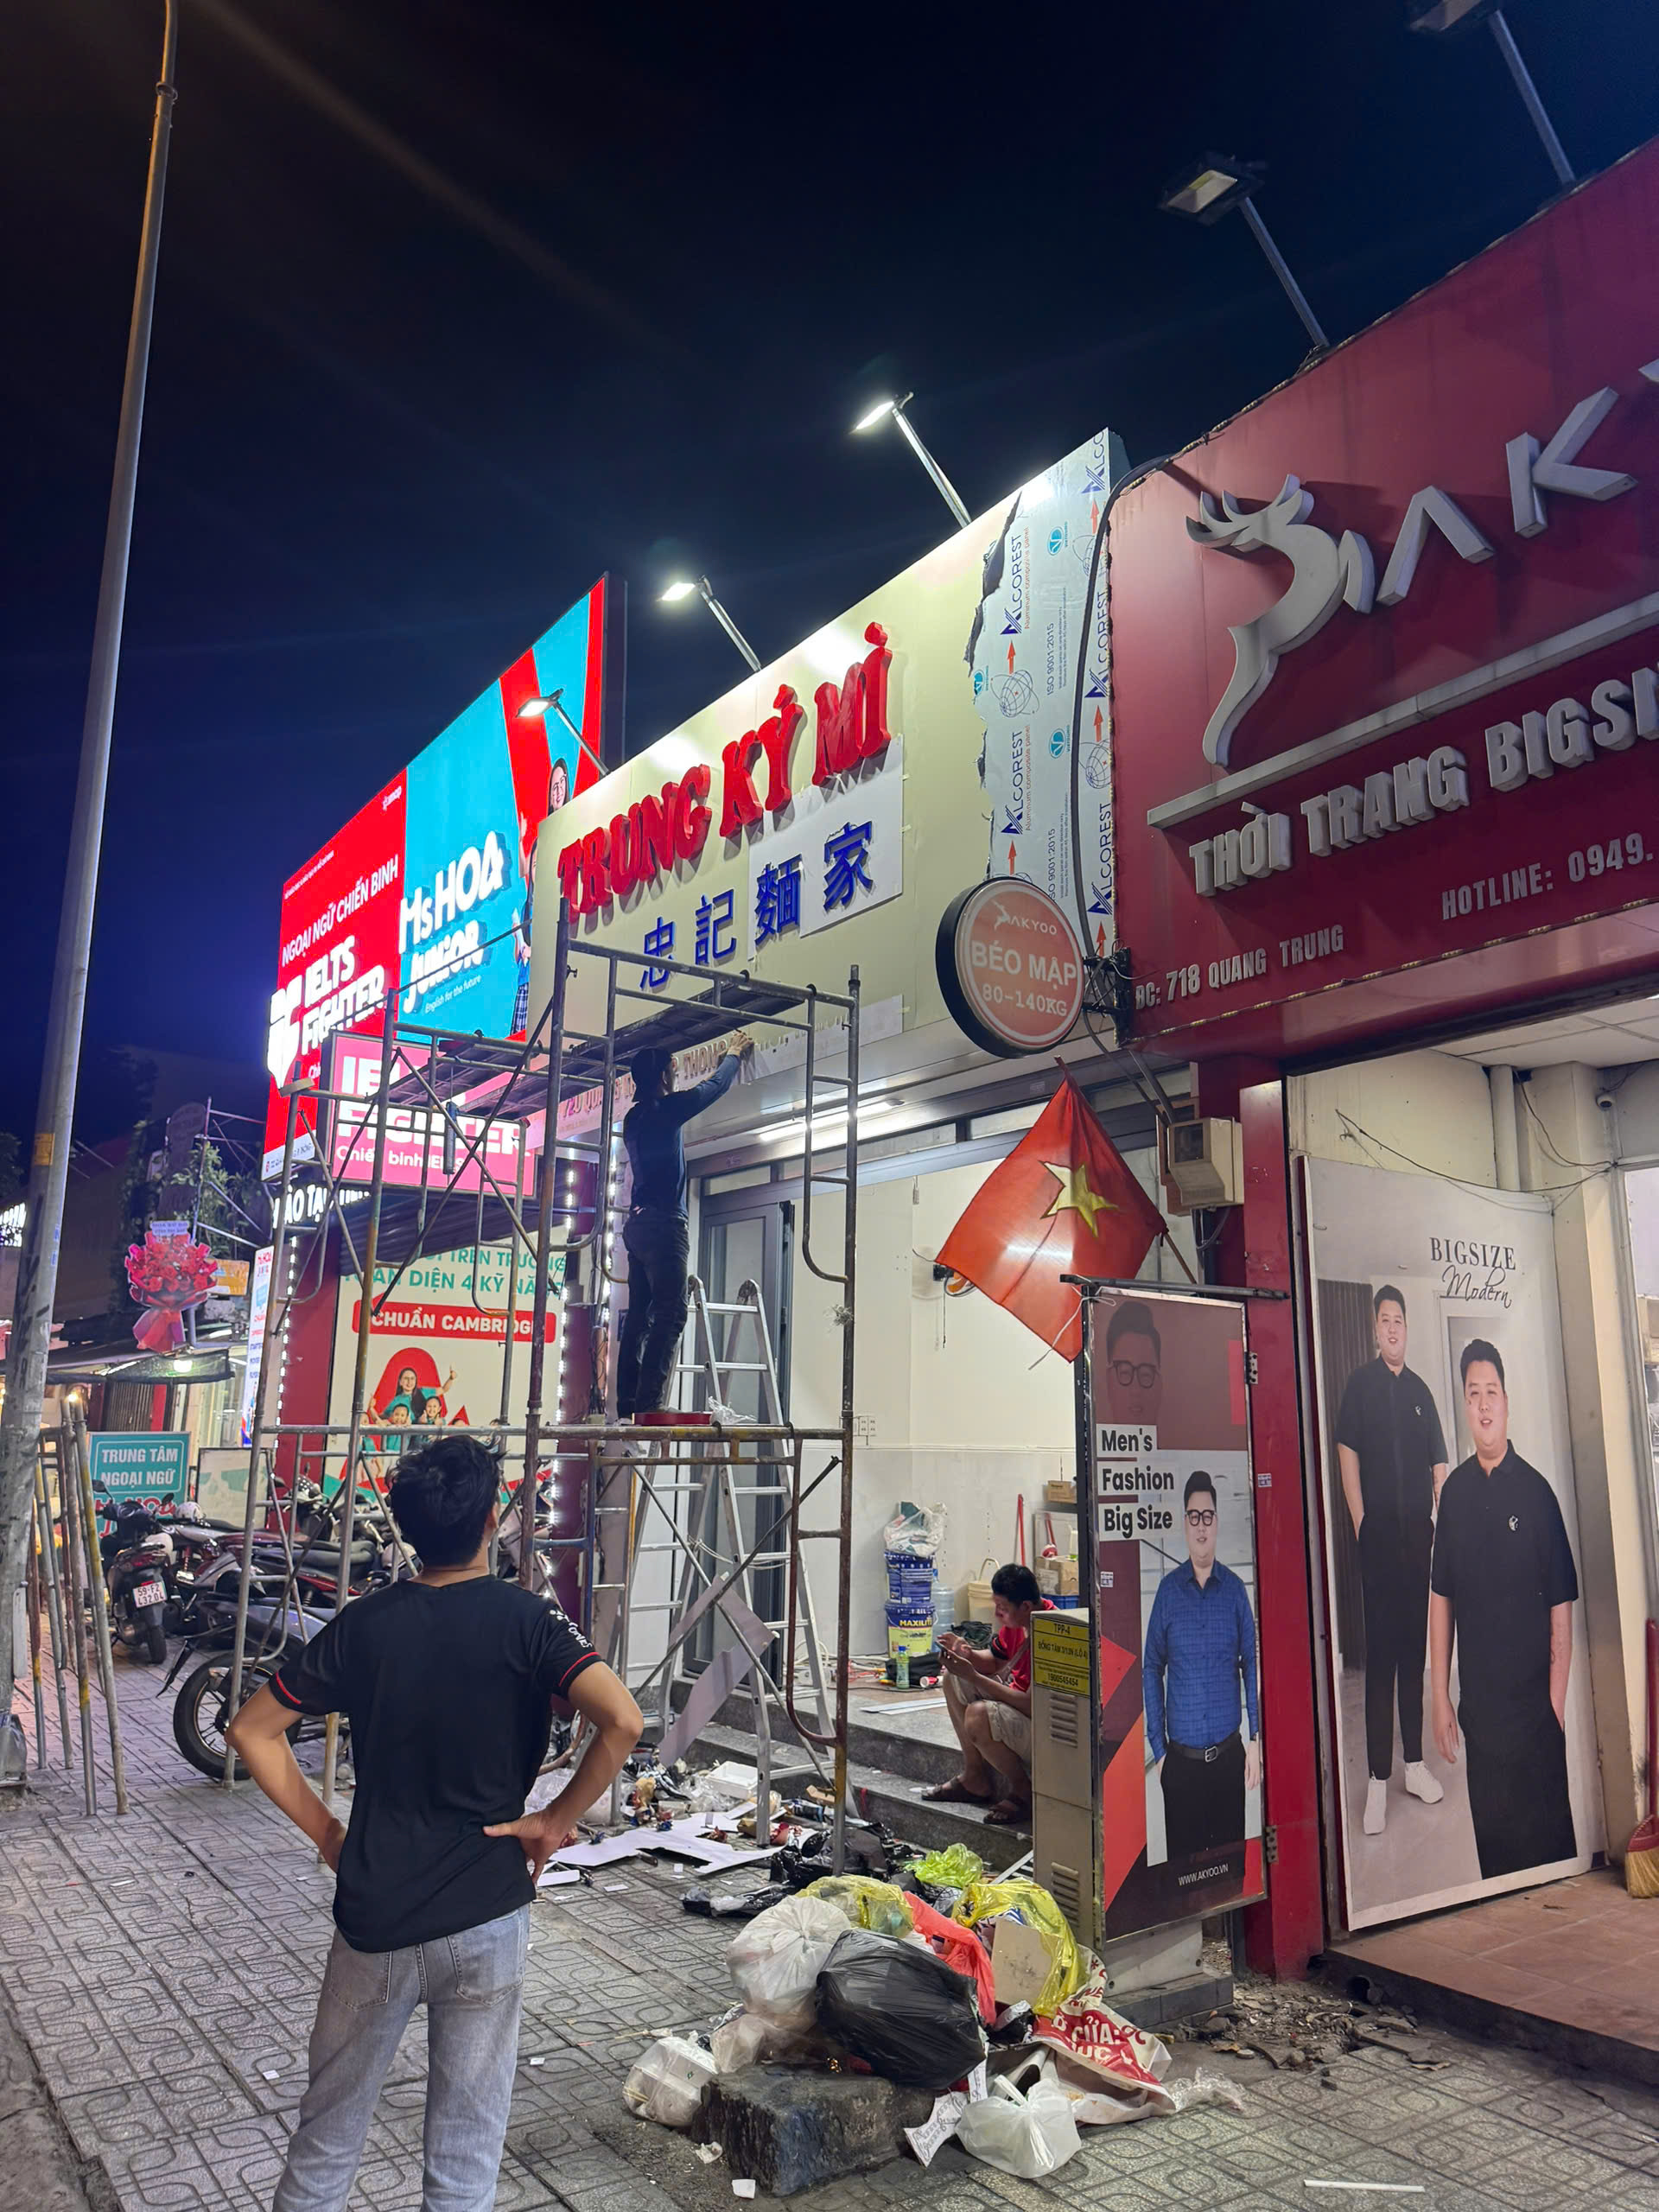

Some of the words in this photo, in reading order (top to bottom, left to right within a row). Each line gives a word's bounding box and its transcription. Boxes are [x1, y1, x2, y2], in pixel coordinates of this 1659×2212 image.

[1485, 662, 1659, 791] BIGSI
[557, 764, 712, 914] TRUNG
[1189, 802, 1291, 897] THỜI
[1301, 747, 1468, 856] TRANG
[282, 926, 312, 968] NGOẠI
[312, 902, 336, 944] NGỮ
[336, 875, 369, 923] CHIẾN
[371, 854, 398, 898] BINH
[640, 821, 874, 990] 忠記麵家
[1441, 865, 1555, 921] HOTLINE:
[304, 935, 356, 1008] IELTS
[970, 939, 1022, 976] BÉO
[1028, 953, 1077, 990] MẬP
[1135, 982, 1160, 1010] ĐC:
[1166, 963, 1201, 1001] 718
[1208, 947, 1268, 989] QUANG
[1279, 924, 1344, 969] TRUNG
[982, 983, 1068, 1017] 80-140KG
[1429, 1236, 1516, 1270] BIGSIZE
[409, 1268, 455, 1293] DIỆN
[461, 1274, 473, 1290] 4
[480, 1272, 505, 1293] KỸ
[1441, 1264, 1513, 1309] Modern
[372, 1306, 435, 1329] CHUẨN
[102, 1448, 146, 1463] TRUNG
[149, 1445, 179, 1463] TÂM
[1101, 1427, 1154, 1452] Men's
[100, 1471, 143, 1489] NGOẠI
[145, 1468, 176, 1485] NGỮ
[1102, 1465, 1175, 1491] Fashion
[1104, 1505, 1134, 1539] Big
[1136, 1503, 1173, 1530] Size
[1178, 1863, 1229, 1886] WWW.AKYOO.VN
